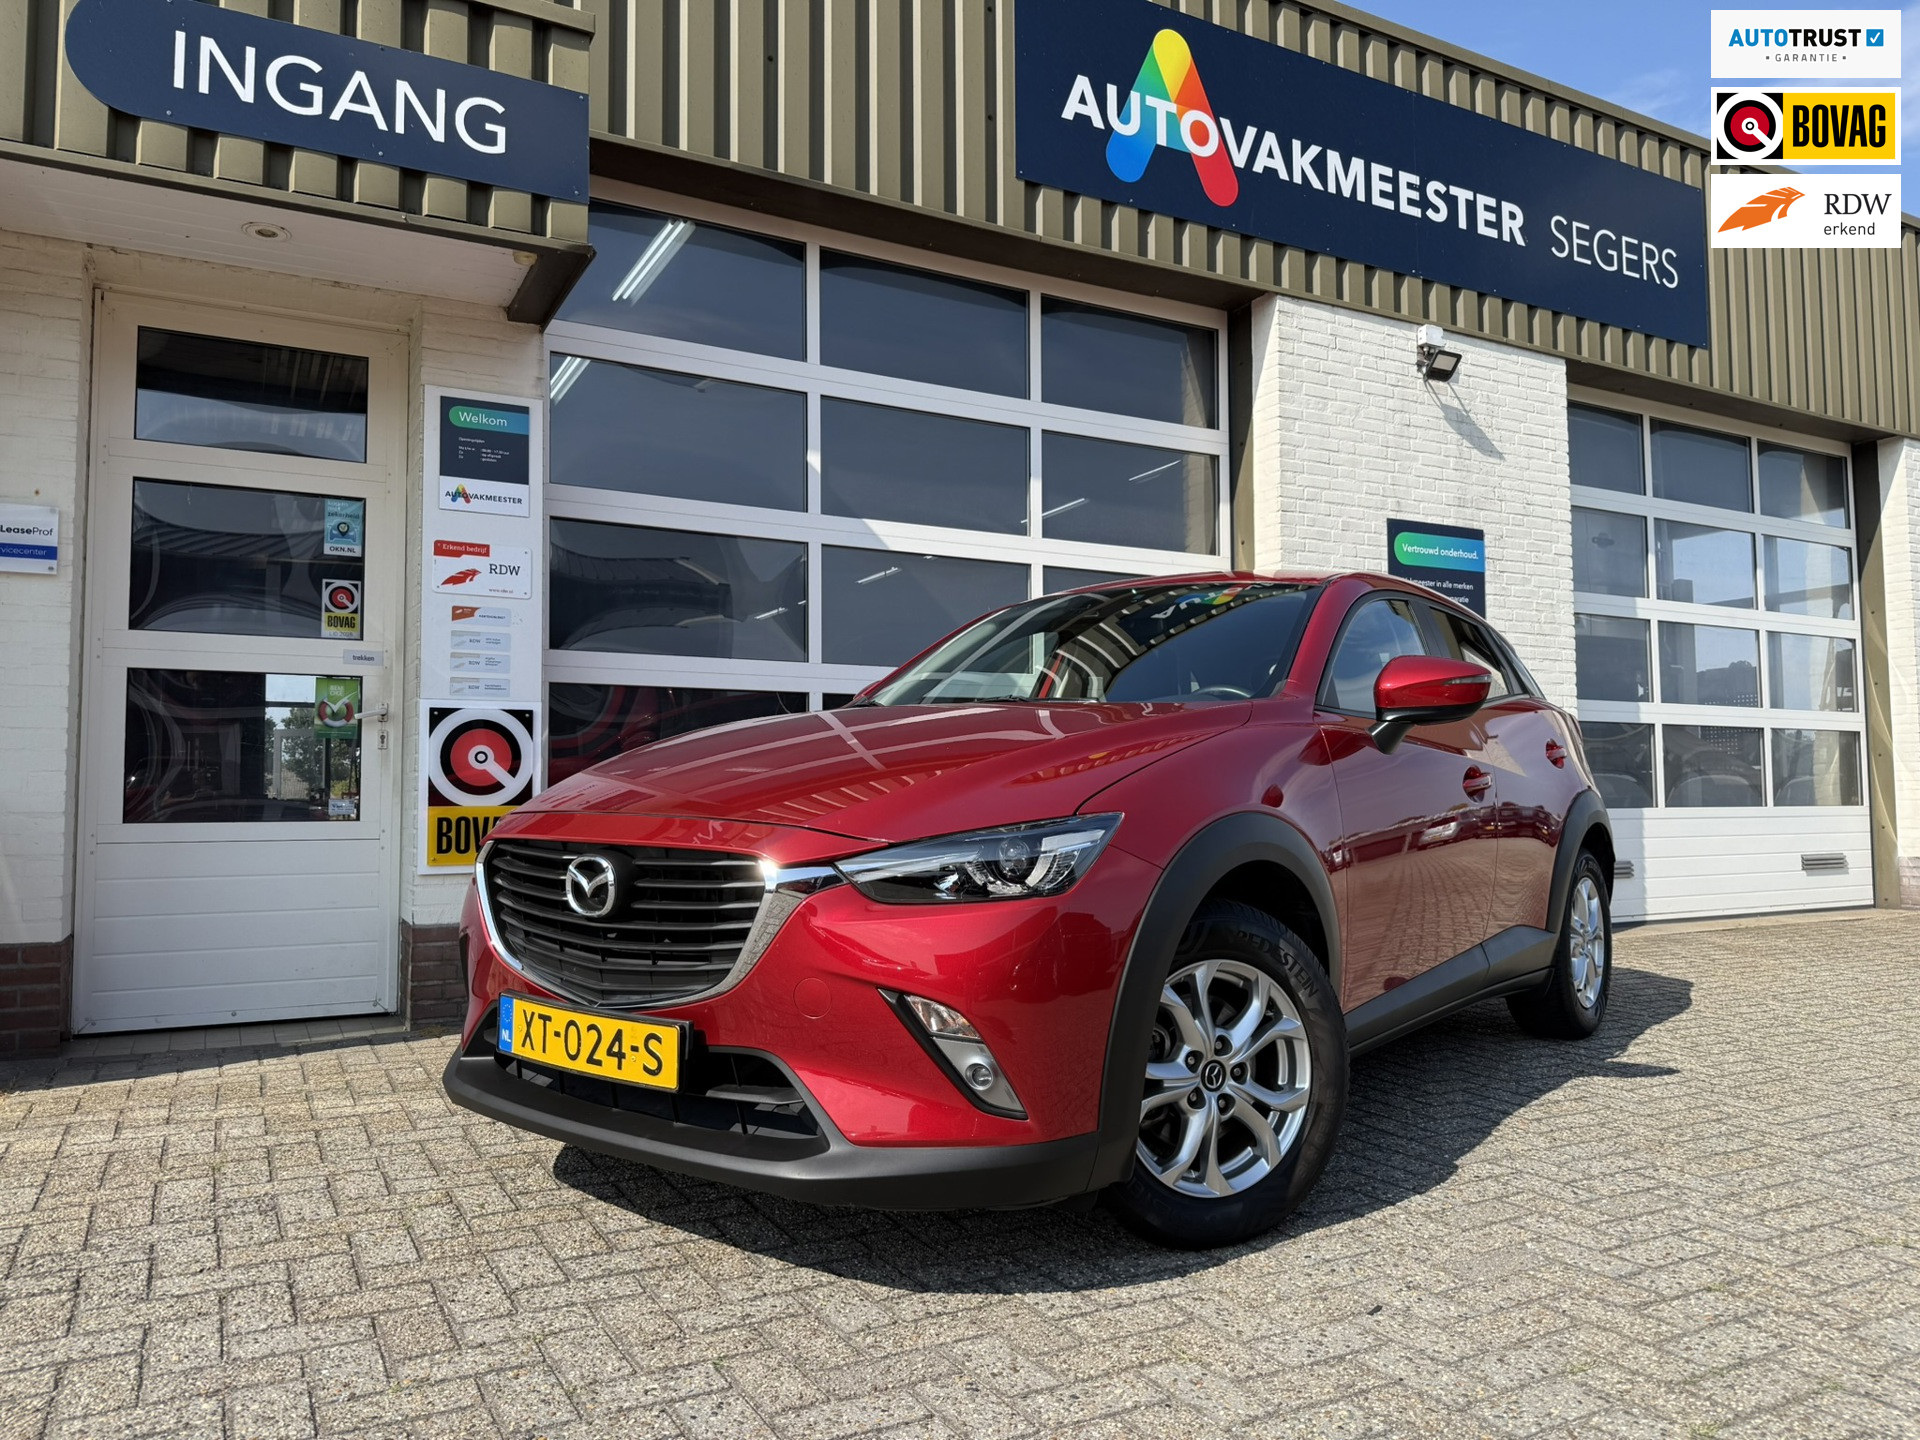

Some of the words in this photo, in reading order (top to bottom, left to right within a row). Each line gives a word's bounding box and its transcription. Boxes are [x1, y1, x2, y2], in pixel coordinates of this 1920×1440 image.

[173, 30, 507, 154] INGANG
[1060, 74, 1527, 248] AUTOVAKMEESTER
[1549, 214, 1680, 290] SEGERS
[458, 411, 508, 427] Welkom
[445, 491, 523, 505] AUTOVAKMEESTER
[0, 525, 54, 536] LeaseProf
[329, 546, 356, 554] OKN.NL
[442, 543, 466, 552] Erkend
[466, 545, 487, 554] bedrijf
[1402, 543, 1439, 555] Vertrouwd
[1440, 548, 1479, 560] onderhoud.
[488, 563, 521, 576] RDW
[1436, 577, 1442, 587] in
[1442, 579, 1453, 589] alle
[1453, 581, 1474, 591] merken
[327, 615, 356, 629] BOVAG
[352, 654, 375, 662] trekken
[436, 816, 501, 855] BOV
[502, 1028, 512, 1043] NL
[521, 1008, 664, 1077] XT-024-S
